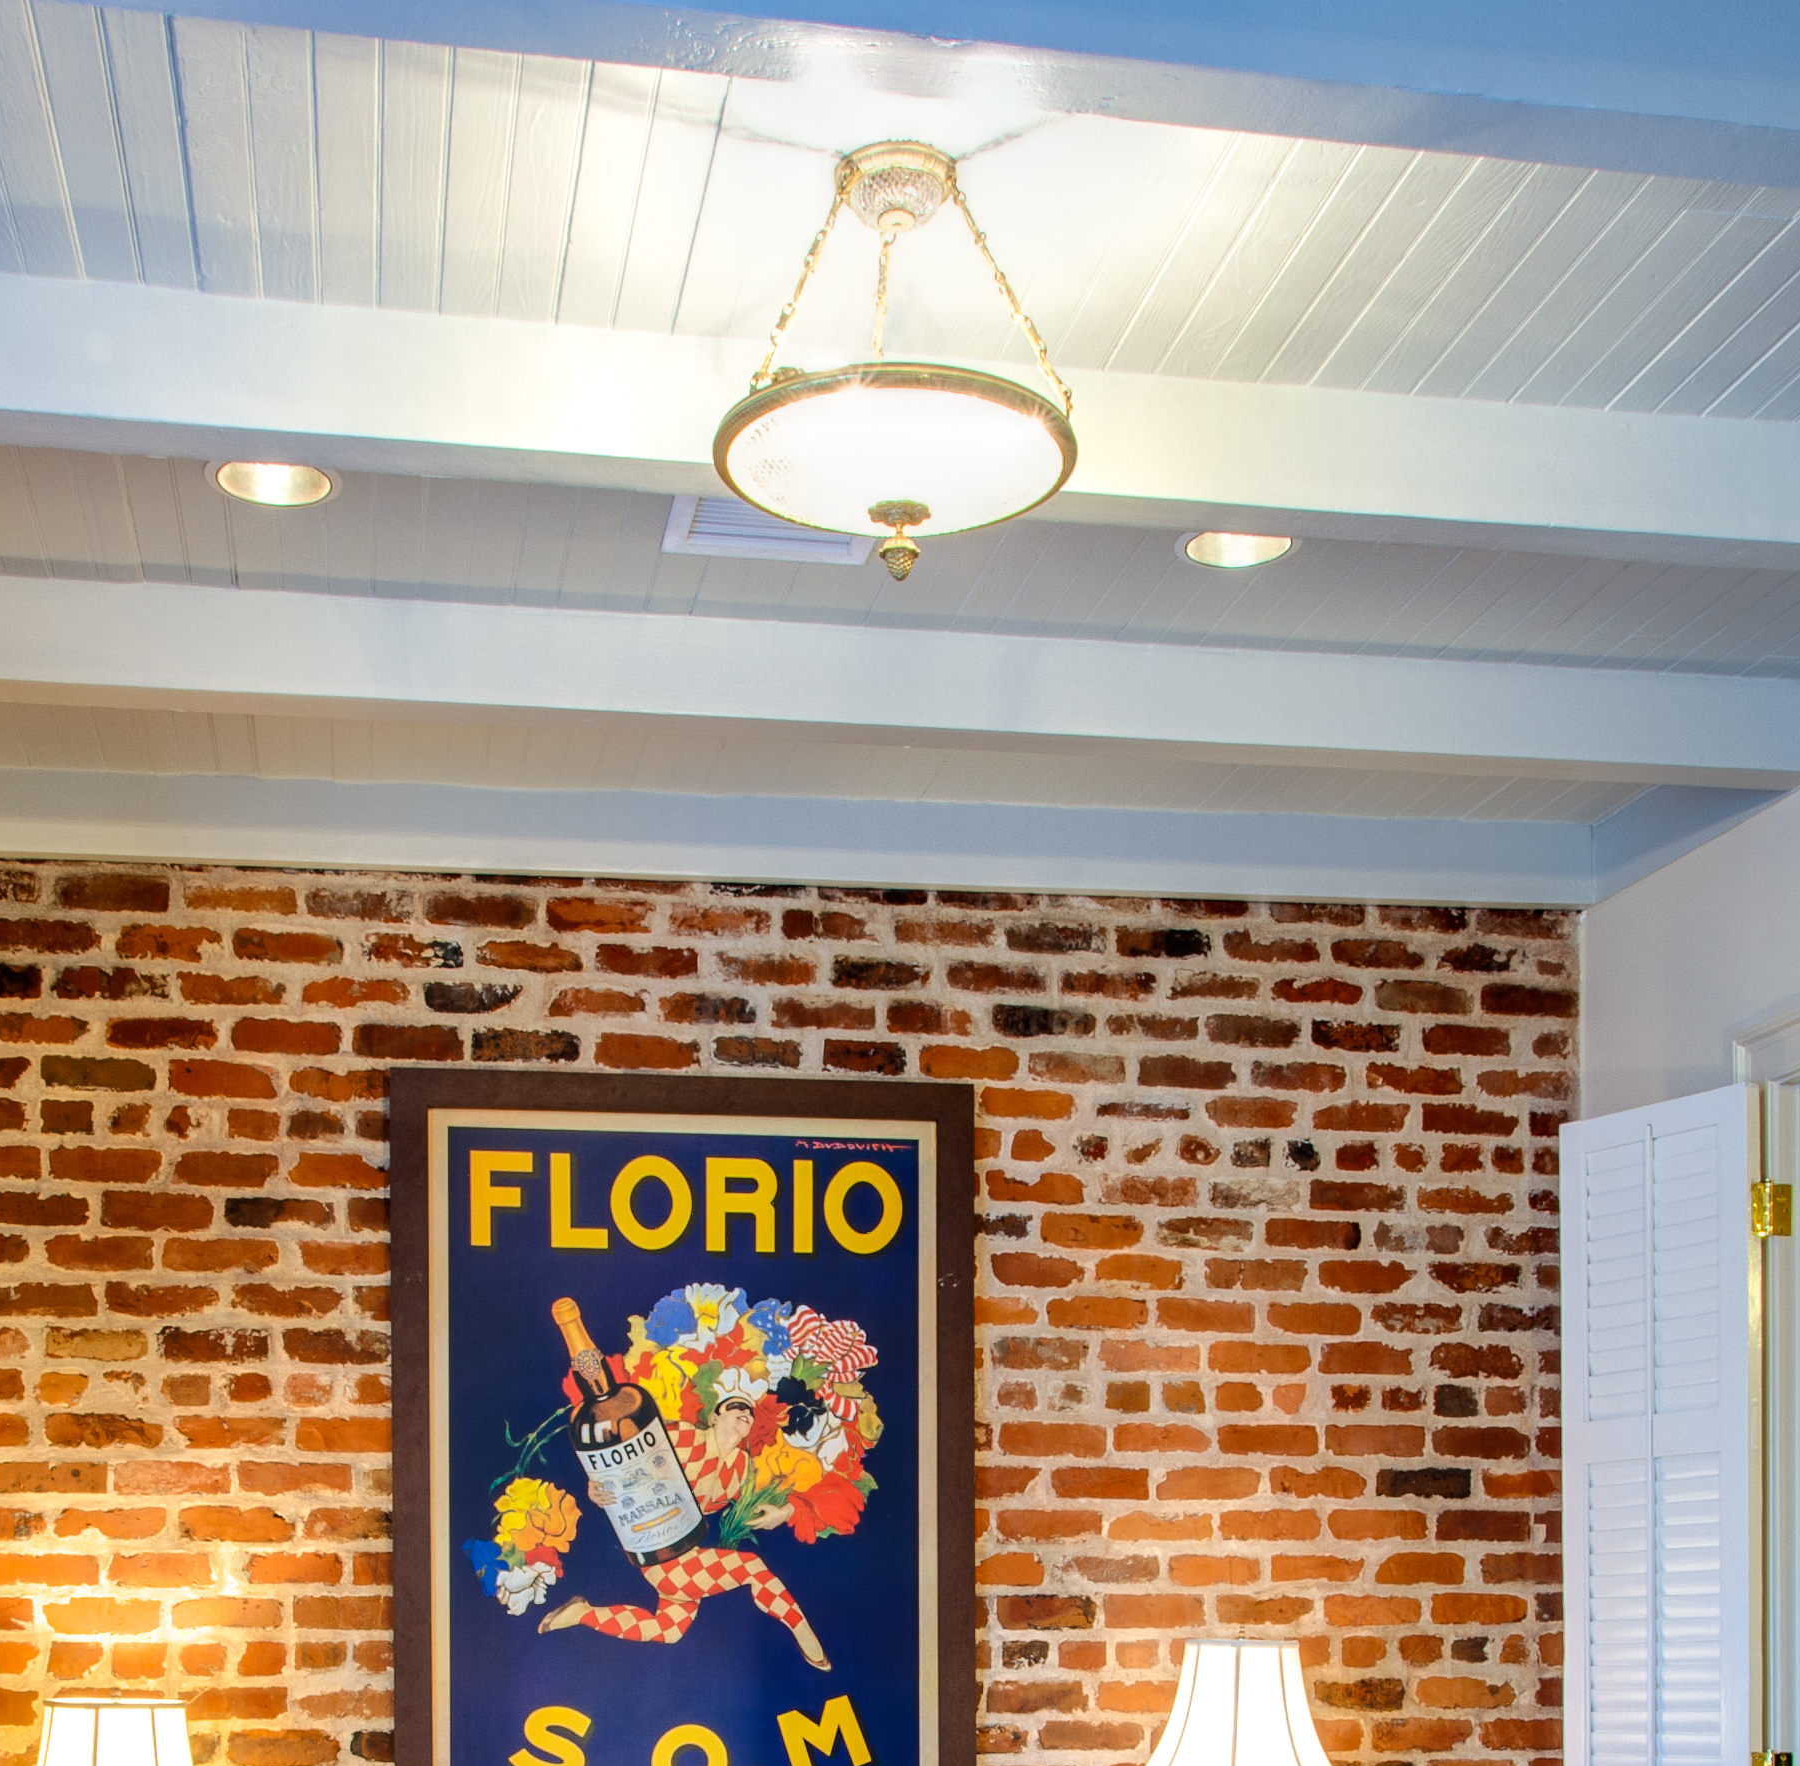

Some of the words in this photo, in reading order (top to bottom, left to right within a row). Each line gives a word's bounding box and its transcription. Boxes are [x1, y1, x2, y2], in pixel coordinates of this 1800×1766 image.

[469, 1149, 903, 1255] FLORIO
[587, 1431, 656, 1470] FLORIO
[618, 1492, 683, 1527] MARSALA
